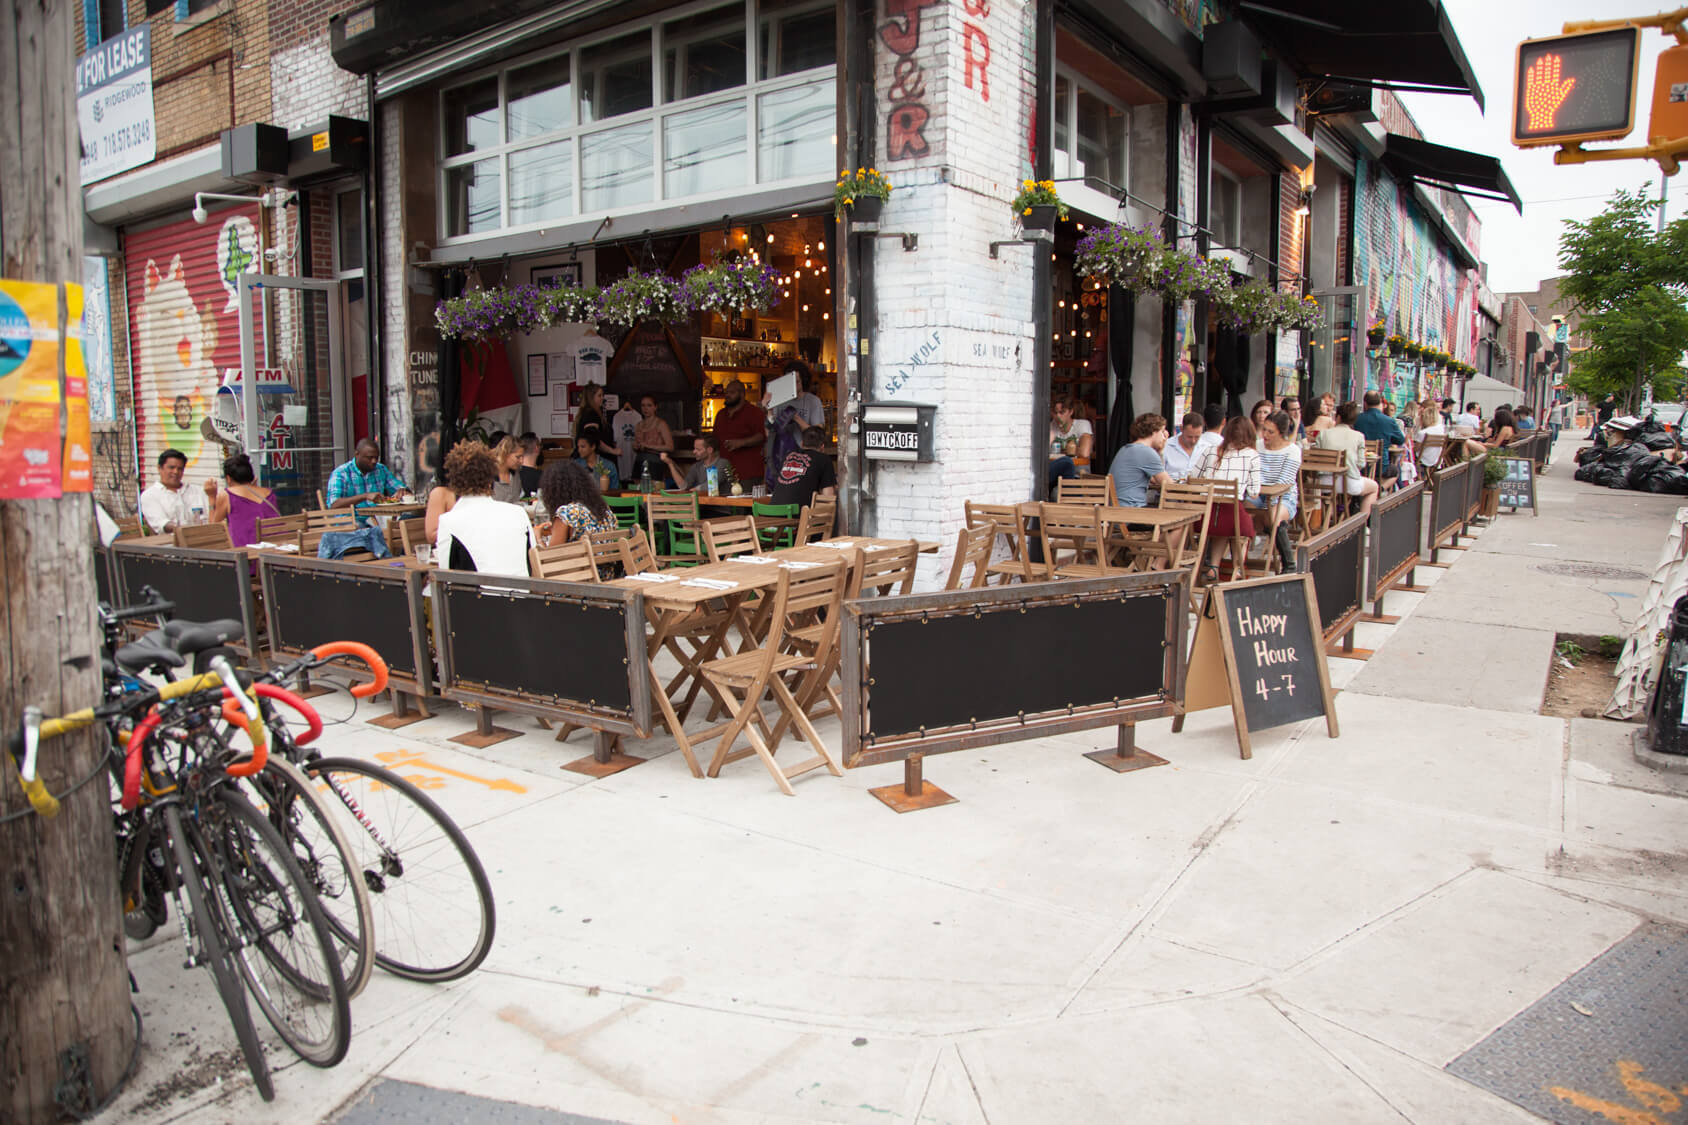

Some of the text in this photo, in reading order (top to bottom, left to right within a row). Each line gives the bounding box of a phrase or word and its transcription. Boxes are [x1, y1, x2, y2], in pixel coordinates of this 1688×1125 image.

[85, 51, 106, 88] FOR
[107, 31, 145, 78] LEASE
[105, 82, 146, 107] RIDGEWOOD
[973, 343, 1012, 360] SEA WOLF
[885, 330, 942, 396] SEA WOLF
[1505, 460, 1530, 480] CE
[1497, 480, 1528, 490] COFFEE
[1499, 494, 1529, 506] TAP
